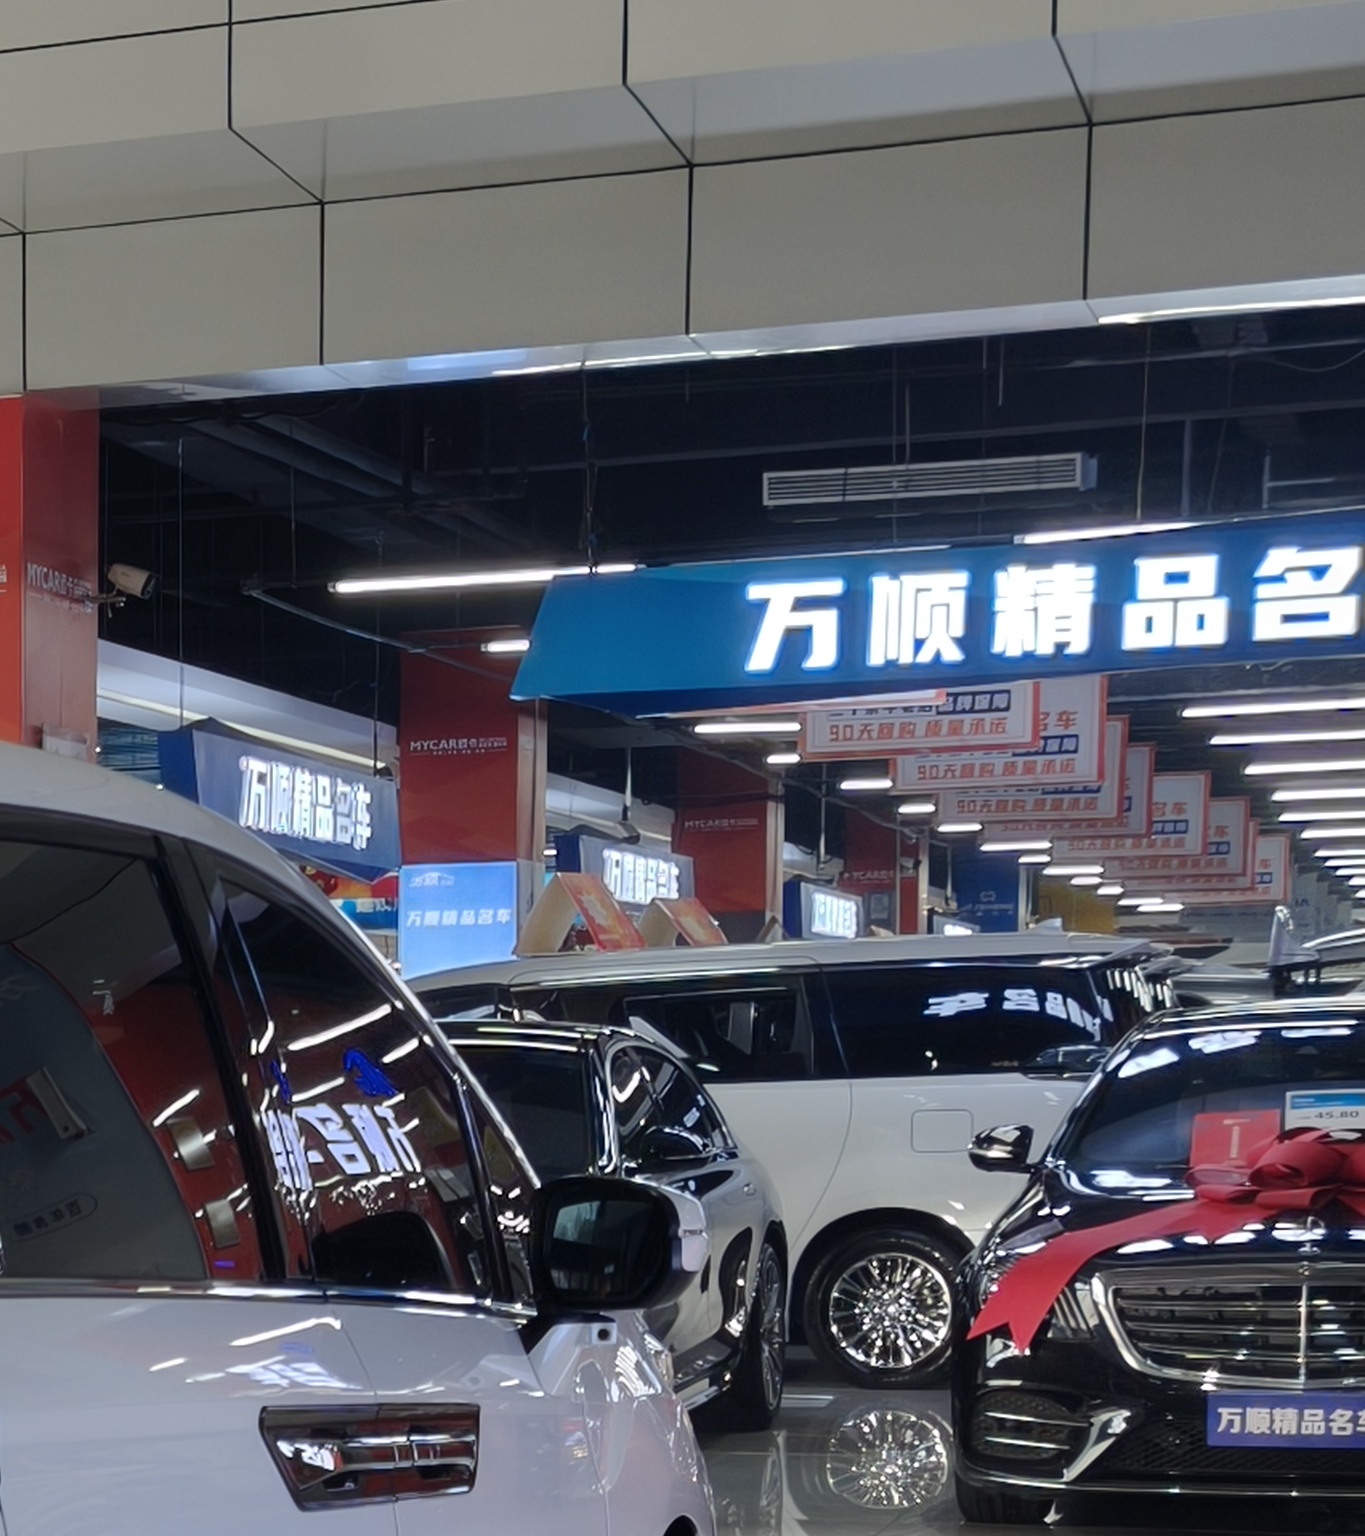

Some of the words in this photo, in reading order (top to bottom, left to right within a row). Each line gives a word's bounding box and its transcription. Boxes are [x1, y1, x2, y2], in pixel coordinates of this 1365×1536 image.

[744, 545, 1363, 673] 万顺精品名
[239, 755, 371, 850] 万顺精品名车
